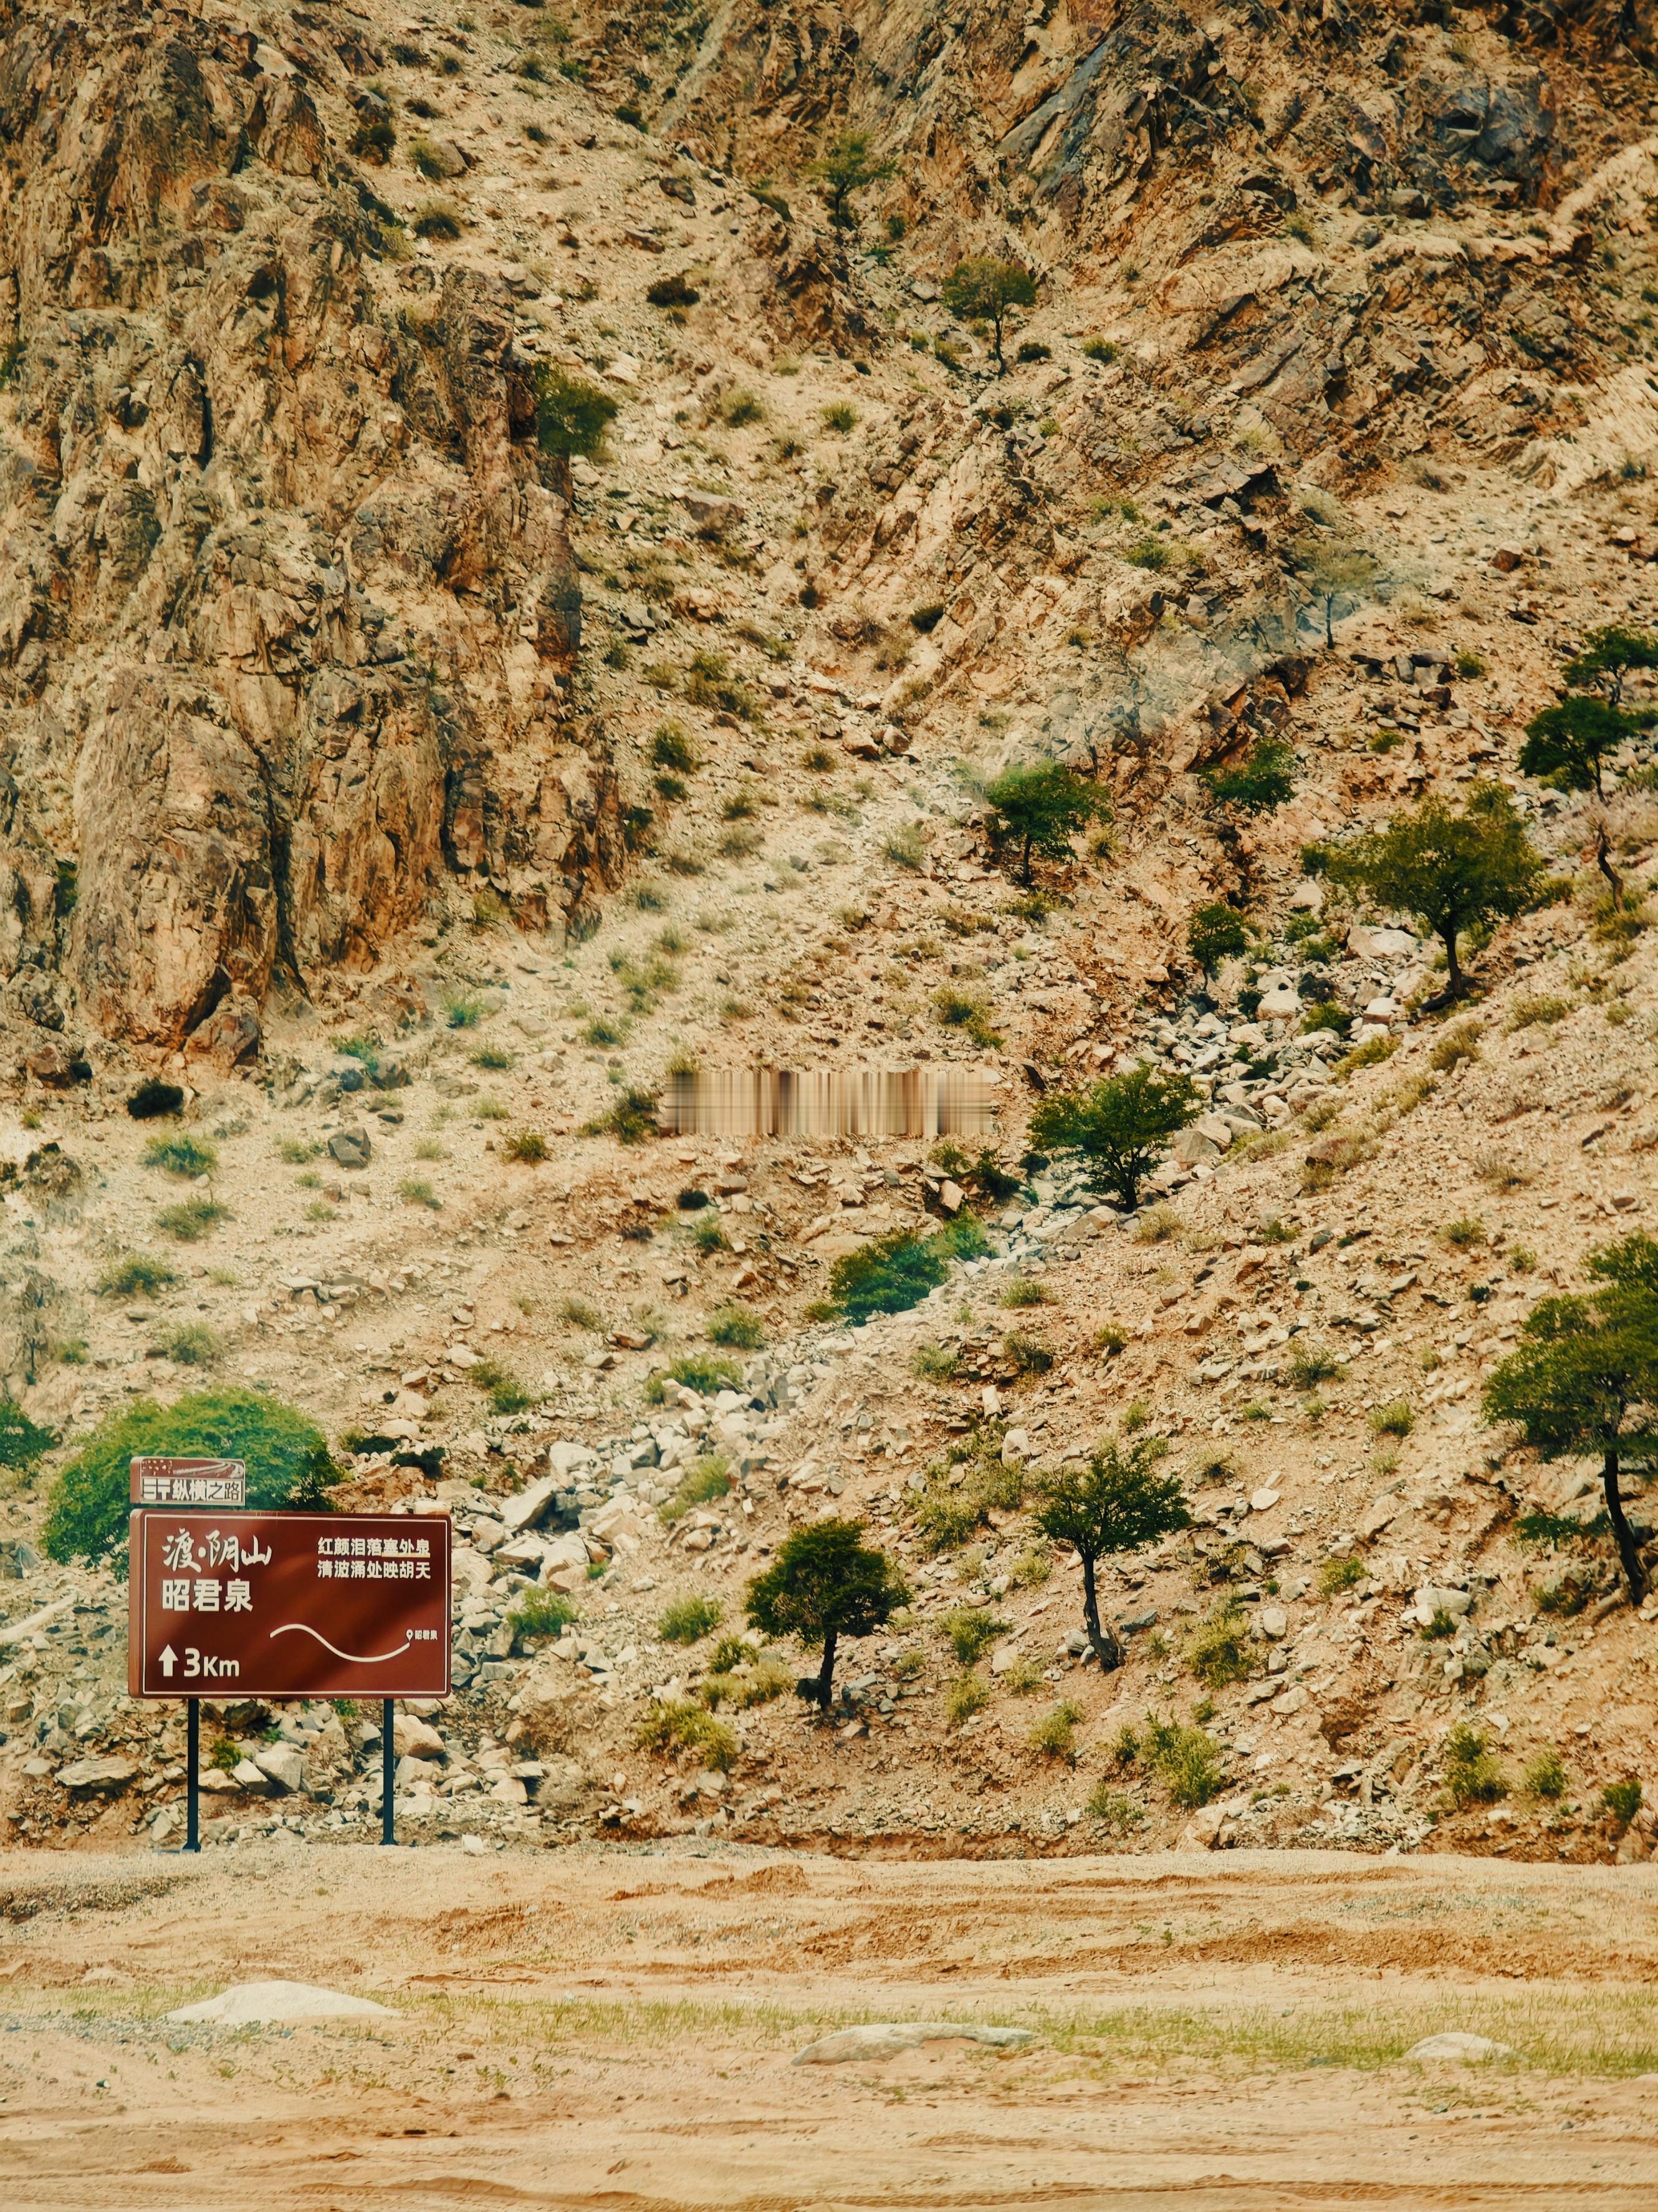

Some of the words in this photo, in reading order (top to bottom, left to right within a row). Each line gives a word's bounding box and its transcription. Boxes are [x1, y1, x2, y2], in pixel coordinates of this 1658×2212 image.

[317, 1536, 430, 1556] 红颜泪落塞外泉
[317, 1559, 431, 1579] 清波涌处映胡天
[161, 1578, 254, 1612] 昭君泉
[414, 1629, 438, 1641] 昭君泉
[183, 1647, 240, 1677] 3Km
